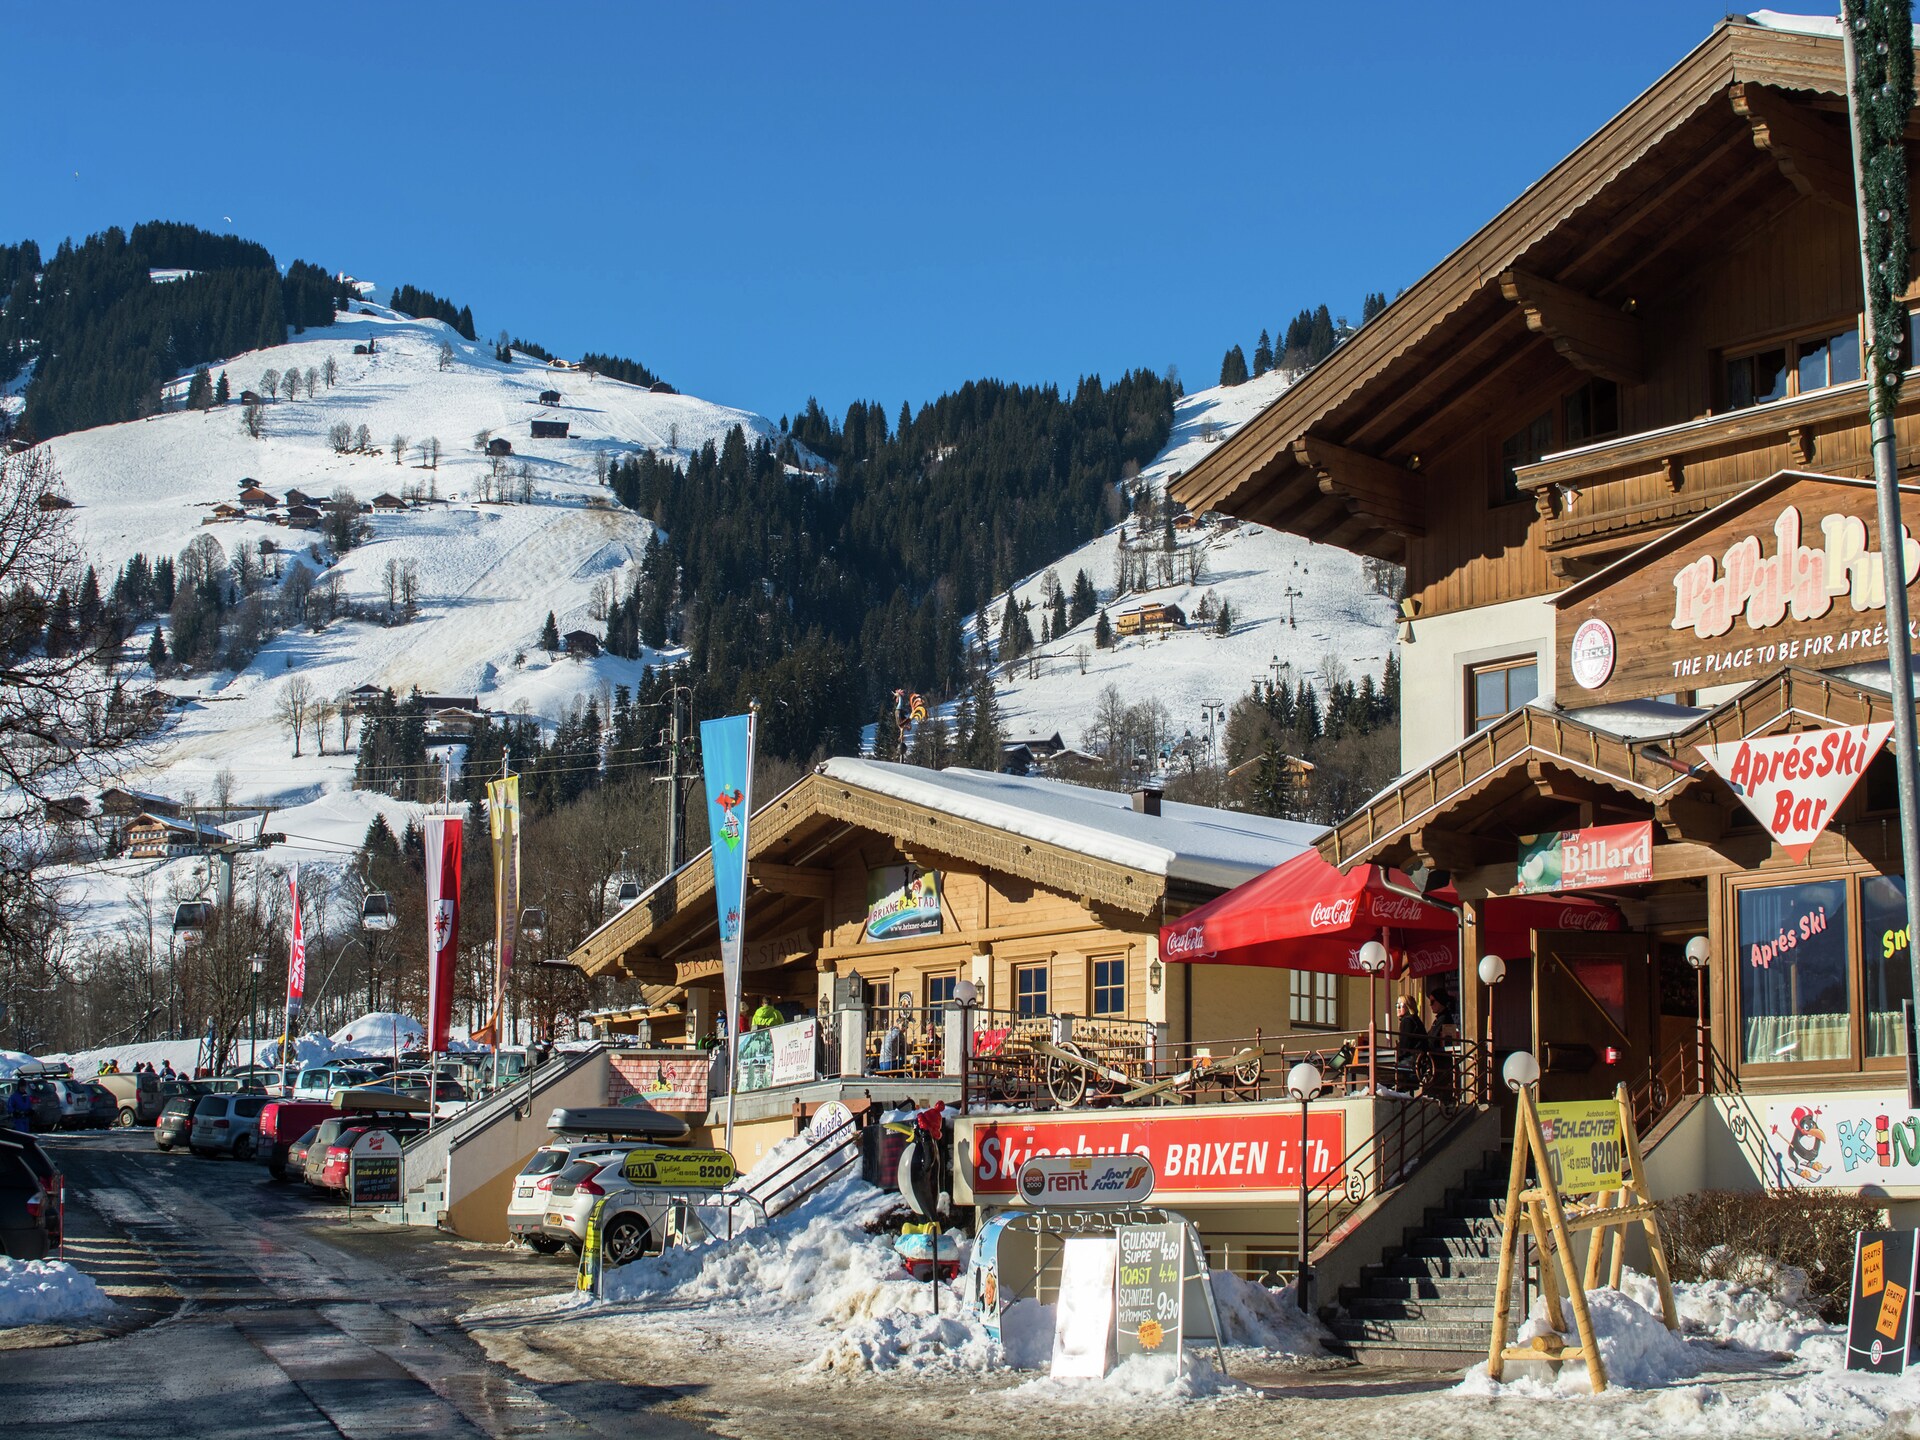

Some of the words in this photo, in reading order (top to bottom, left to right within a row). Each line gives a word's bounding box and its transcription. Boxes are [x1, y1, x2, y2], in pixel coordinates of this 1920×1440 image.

[1673, 655, 1701, 678] THE
[1706, 647, 1753, 673] PLACE
[1757, 643, 1776, 663] TO
[1779, 640, 1800, 661] BE
[1804, 634, 1834, 657] FOR
[1771, 789, 1827, 834] Bar
[1562, 831, 1580, 843] Play
[1563, 834, 1650, 874] Billard
[1623, 868, 1652, 881] here!!!
[873, 900, 905, 922] BRIXNER
[1311, 898, 1356, 928] Coca-Cola
[1372, 895, 1422, 921] Coca-Cola
[1558, 906, 1610, 931] Coca-Cola
[1166, 924, 1205, 957] Coca-Cola
[1751, 927, 1798, 969] Aprés
[1799, 906, 1827, 941] Ski
[1553, 1118, 1615, 1140] SCHLECHTER
[654, 1153, 723, 1163] SCHLECHTER
[1164, 1141, 1269, 1177] BRIXEN
[1591, 1140, 1620, 1175] 8200
[627, 1162, 652, 1177] TAXI
[699, 1165, 731, 1178] 8200
[1025, 1175, 1043, 1183] SPORT
[1101, 1167, 1133, 1181] Sport
[1048, 1169, 1088, 1192] rent
[1121, 1230, 1161, 1251] GULASCH
[1125, 1249, 1153, 1264] SUPPE
[1863, 1247, 1882, 1262] GRATIS
[1119, 1265, 1152, 1286] TOAST
[1867, 1279, 1879, 1289] WIFI
[1119, 1287, 1155, 1308] SCHNITZEL
[1156, 1291, 1179, 1321] 9.90
[1885, 1288, 1903, 1304] GRATIS
[1881, 1318, 1894, 1330] WIFI
